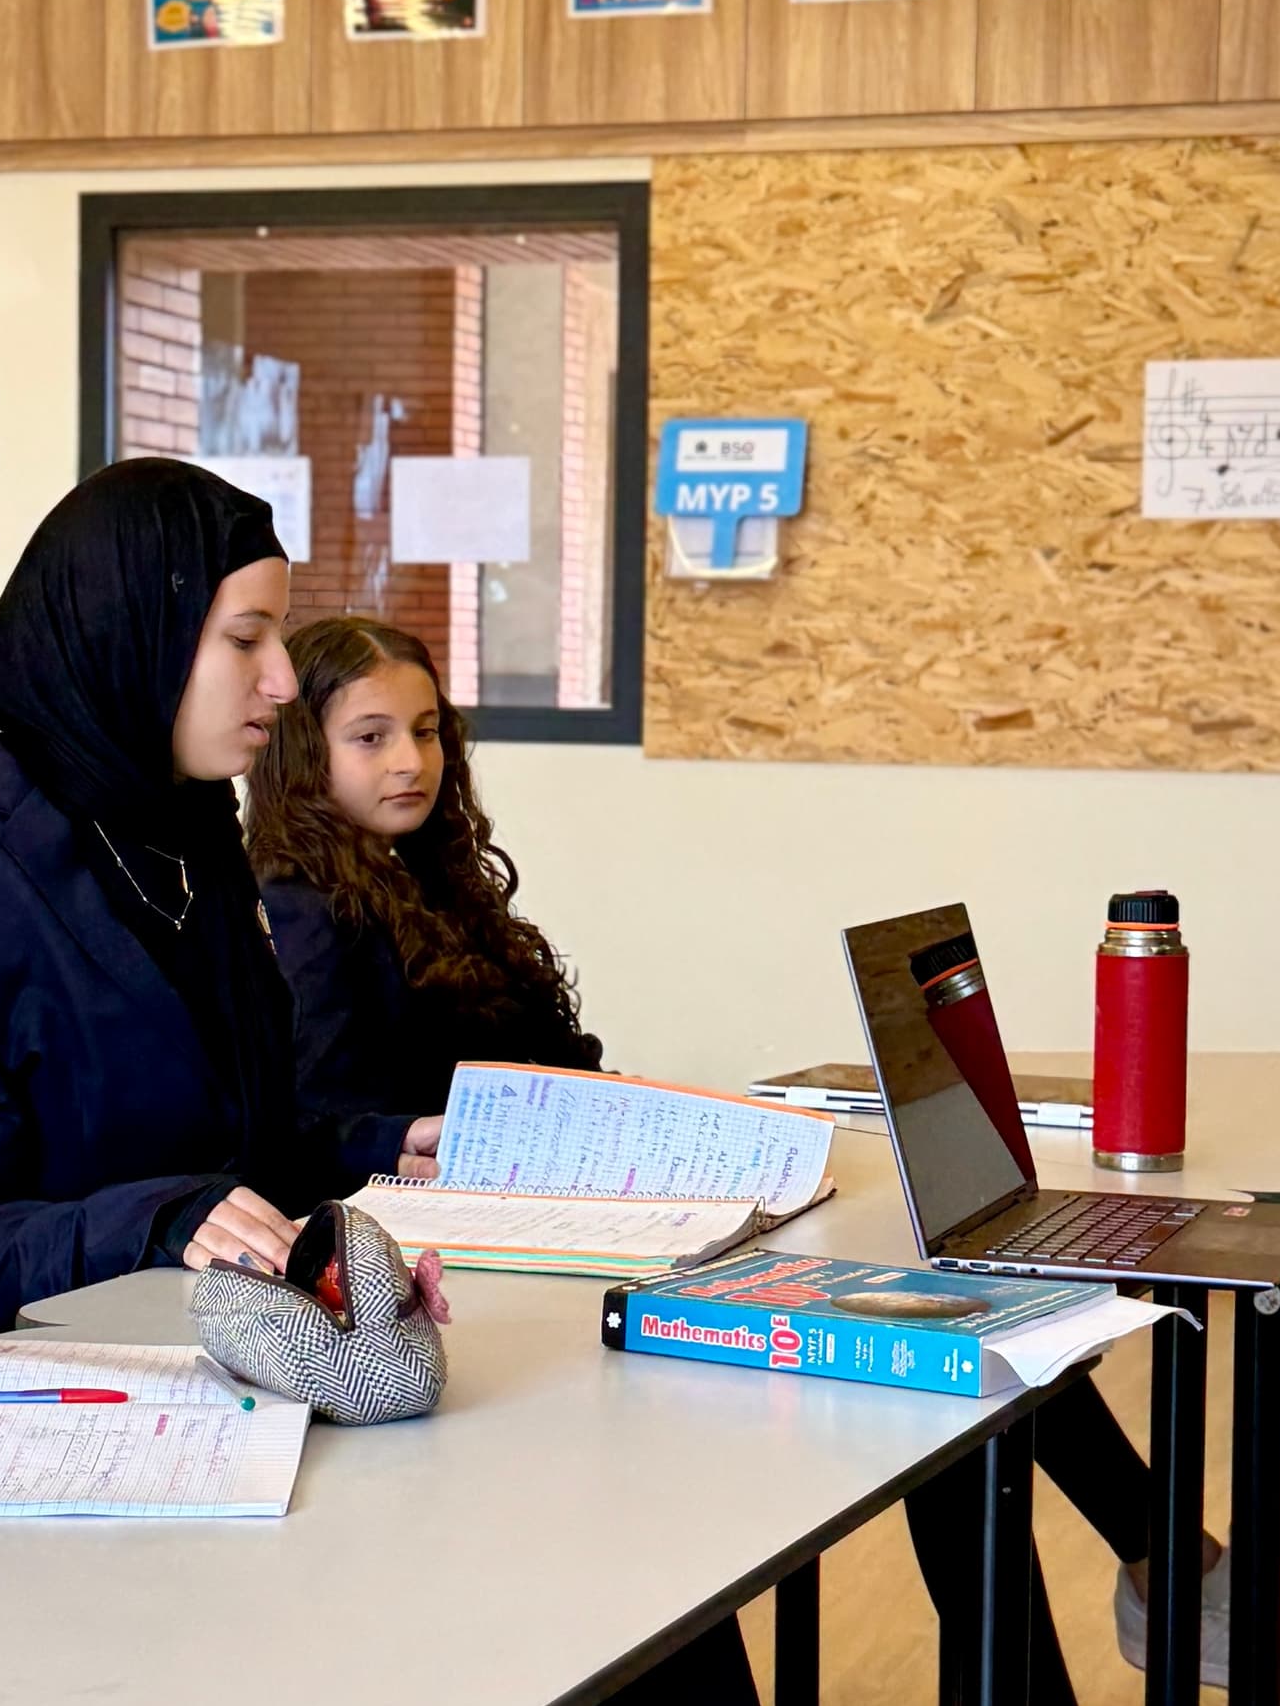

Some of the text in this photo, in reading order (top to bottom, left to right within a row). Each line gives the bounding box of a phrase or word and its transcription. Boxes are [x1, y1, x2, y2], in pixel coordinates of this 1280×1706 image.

[720, 441, 755, 456] BSO
[676, 482, 780, 512] MYP 5
[640, 1313, 768, 1353] Mathematics
